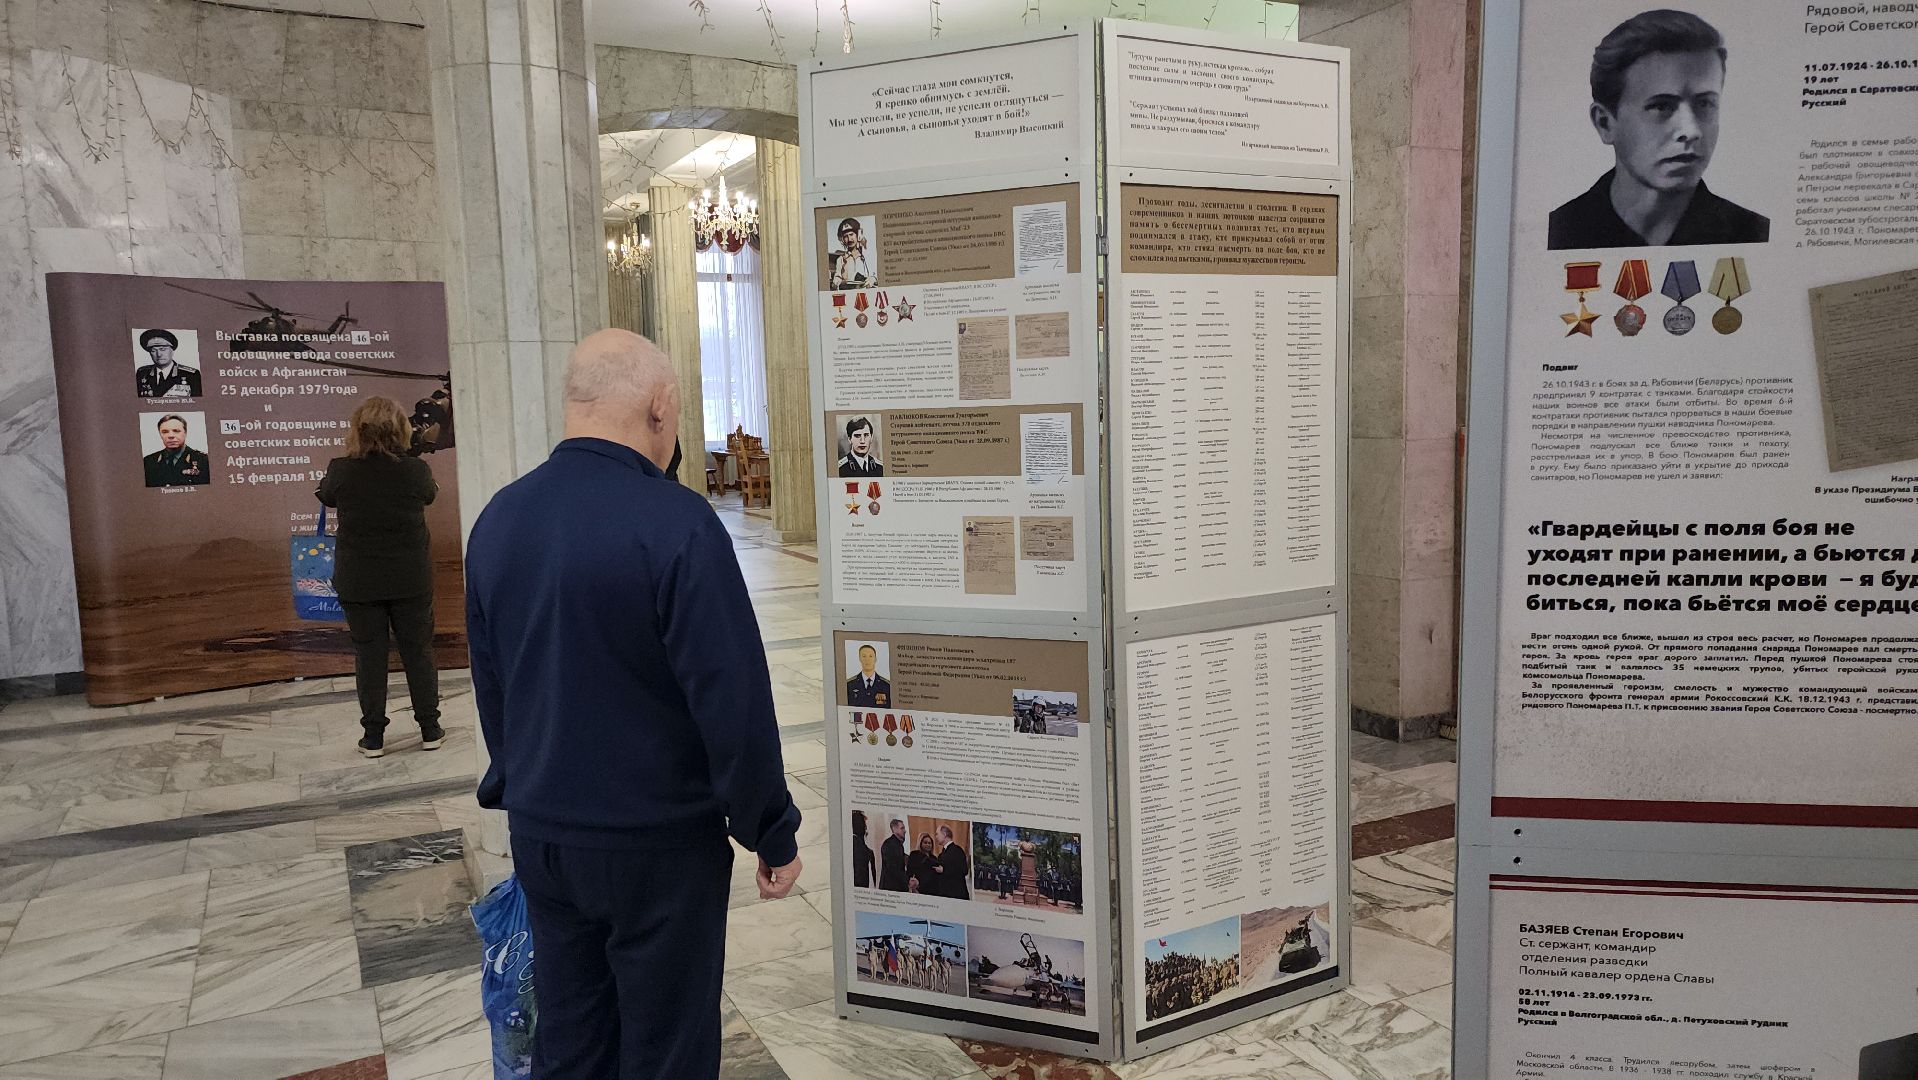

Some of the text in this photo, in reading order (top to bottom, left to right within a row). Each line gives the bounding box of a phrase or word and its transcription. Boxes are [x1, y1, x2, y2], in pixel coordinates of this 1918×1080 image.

[1807, 2, 1869, 17] Рядовой,
[1805, 21, 1845, 35] Герой
[1804, 62, 1867, 72] 11.07.1924
[872, 71, 1014, 97] «Сейчас глаза мои сомкнутся,
[875, 101, 882, 109] Я
[885, 97, 918, 110] крепко
[920, 93, 964, 105] обнимусь
[1802, 98, 1846, 109] Русский
[829, 118, 845, 128] Мы
[848, 117, 857, 125] не
[860, 111, 894, 126] успели,
[896, 112, 906, 120] не
[909, 106, 943, 120] успели,
[945, 105, 956, 115] не
[959, 100, 991, 115] успели
[994, 93, 1049, 108] оглянуться
[858, 128, 865, 138] А
[866, 124, 909, 137] сыновья,
[919, 118, 959, 130] сыновья
[962, 114, 994, 127] уходят
[974, 121, 1064, 139] Владимир Высоцкий
[216, 330, 278, 342] Выставка
[282, 334, 350, 343] посвящена
[218, 350, 395, 360] годовщине ввода советских
[219, 367, 347, 379] войск в Афганистан
[221, 385, 237, 395] 25
[241, 384, 294, 397] декабря
[264, 404, 272, 412] и
[266, 420, 336, 431] годовщине
[225, 439, 290, 448] советских
[294, 436, 330, 446] войск
[227, 455, 310, 468] Афганистана
[228, 474, 244, 484] 15
[248, 472, 305, 485] февраля
[1852, 486, 1910, 494] Президиума
[291, 512, 313, 520] Всем
[1528, 518, 1855, 540] «Гвардейцы с поля боя не
[1527, 549, 1613, 565] уходят
[1619, 549, 1665, 565] при
[1672, 548, 1788, 565] ранении,
[1794, 548, 1807, 561] а
[1814, 544, 1905, 561] бьются
[1527, 570, 1660, 587] последней
[1667, 574, 1742, 587] капли
[1750, 574, 1827, 591] крови
[1859, 574, 1873, 586] я
[1526, 594, 1616, 612] биться,
[1623, 598, 1681, 610] пока
[1688, 594, 1770, 611] бьётся
[1778, 594, 1827, 611] моё
[1531, 633, 1551, 641] Враг
[1555, 633, 1599, 642] подходил
[1622, 633, 1654, 641] ближе,
[1813, 635, 1867, 643] Пономарев
[1519, 924, 1684, 940] БАЗЯЕВ Степан Егорович
[1520, 938, 1656, 954] Ст. сержант, командир
[1522, 954, 1648, 967] отделения разведки
[1519, 966, 1714, 984] Полный кавалер ордена Славы
[1518, 989, 1575, 998] 02.11.1914
[1583, 991, 1639, 1001] 23.09.1973
[1518, 1008, 1558, 1017] Родился
[1569, 1010, 1642, 1021] Волгоградской
[1683, 1016, 1748, 1026] Петуховский
[1751, 1019, 1788, 1028] Рудник
[1518, 1017, 1557, 1026] Русский
